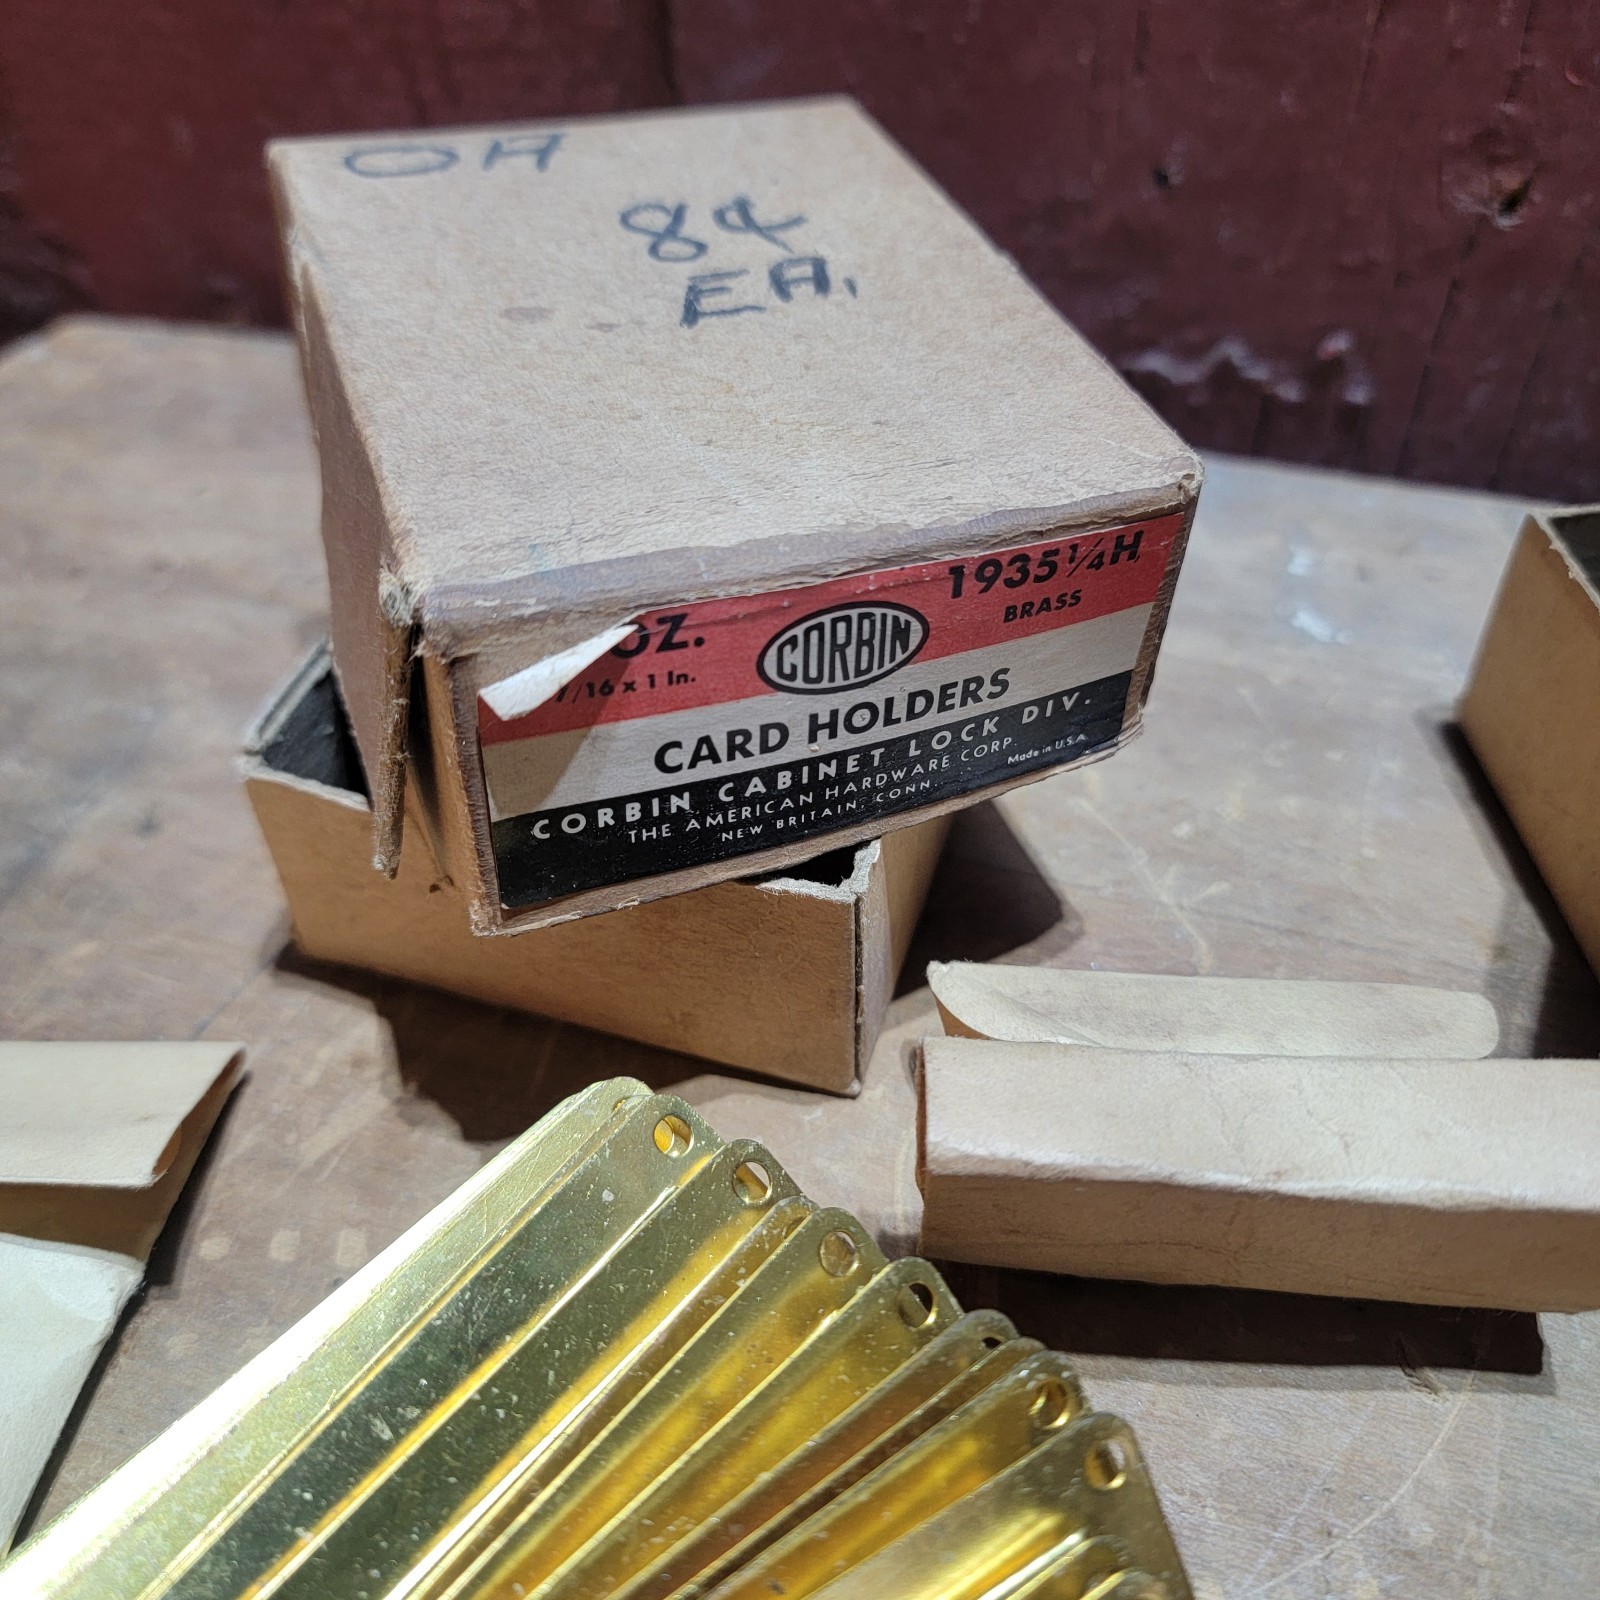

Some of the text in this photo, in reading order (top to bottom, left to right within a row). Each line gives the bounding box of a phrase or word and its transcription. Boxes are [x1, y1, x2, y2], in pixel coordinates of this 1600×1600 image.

[1003, 589, 1082, 624] BRASS
[776, 606, 912, 685] CORBIN
[622, 680, 637, 693] x
[647, 674, 656, 688] 1
[654, 667, 1010, 774] CARD HOLDERS
[532, 691, 1092, 839] CORBIN CABINET LOCK DIV.
[1007, 750, 1039, 765] Made
[1042, 744, 1052, 753] in
[628, 823, 672, 844] THE
[685, 791, 814, 832] AMERICAN
[825, 754, 950, 800] HARDWARE
[721, 824, 763, 842] NEW
